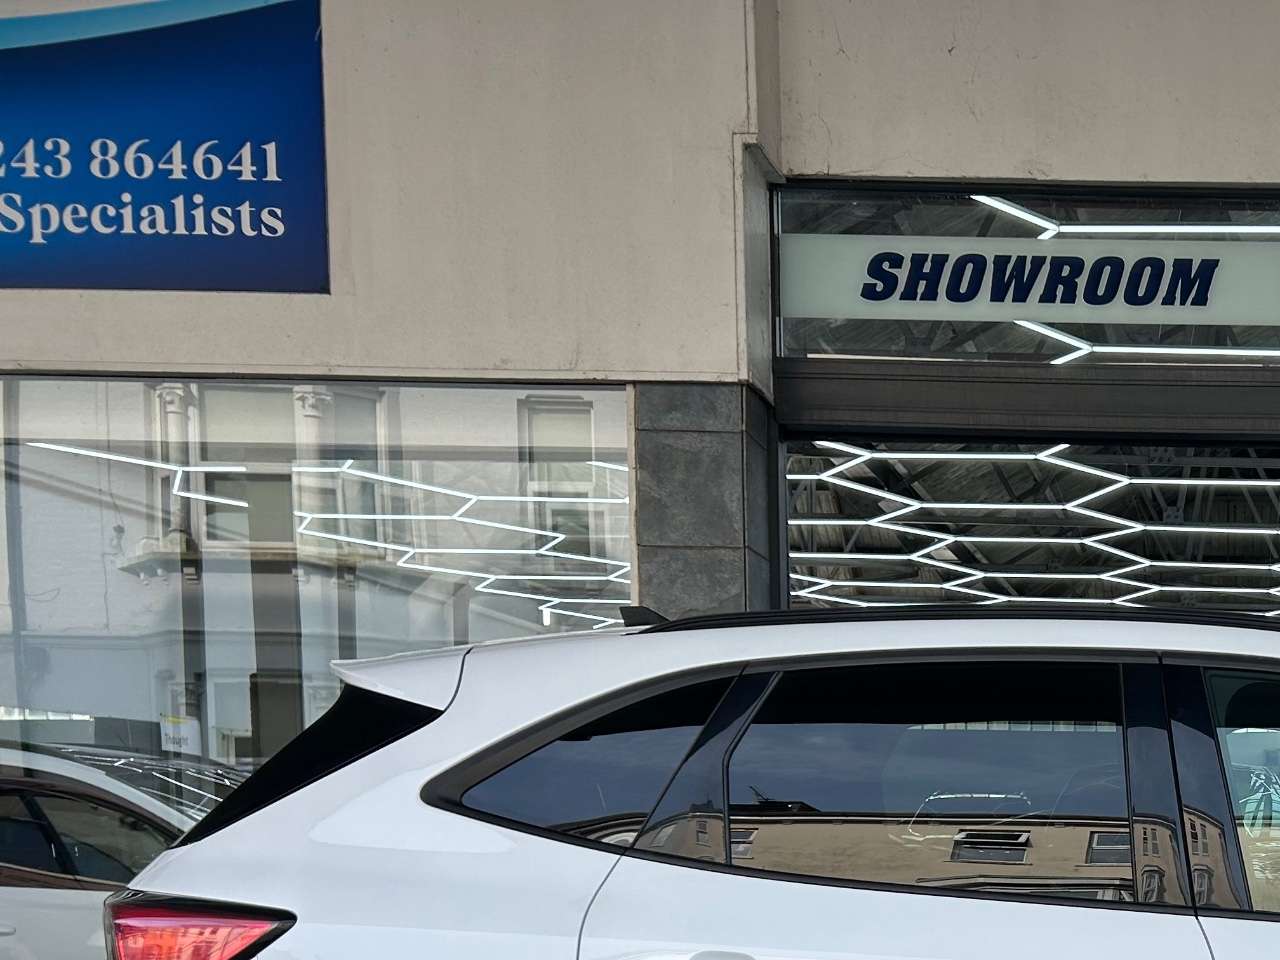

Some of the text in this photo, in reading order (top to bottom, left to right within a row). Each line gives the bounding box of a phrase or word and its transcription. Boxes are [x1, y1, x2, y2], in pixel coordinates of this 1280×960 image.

[89, 138, 283, 182] 864641
[0, 192, 286, 244] Specialists
[860, 251, 1220, 307] SHOWROOM
